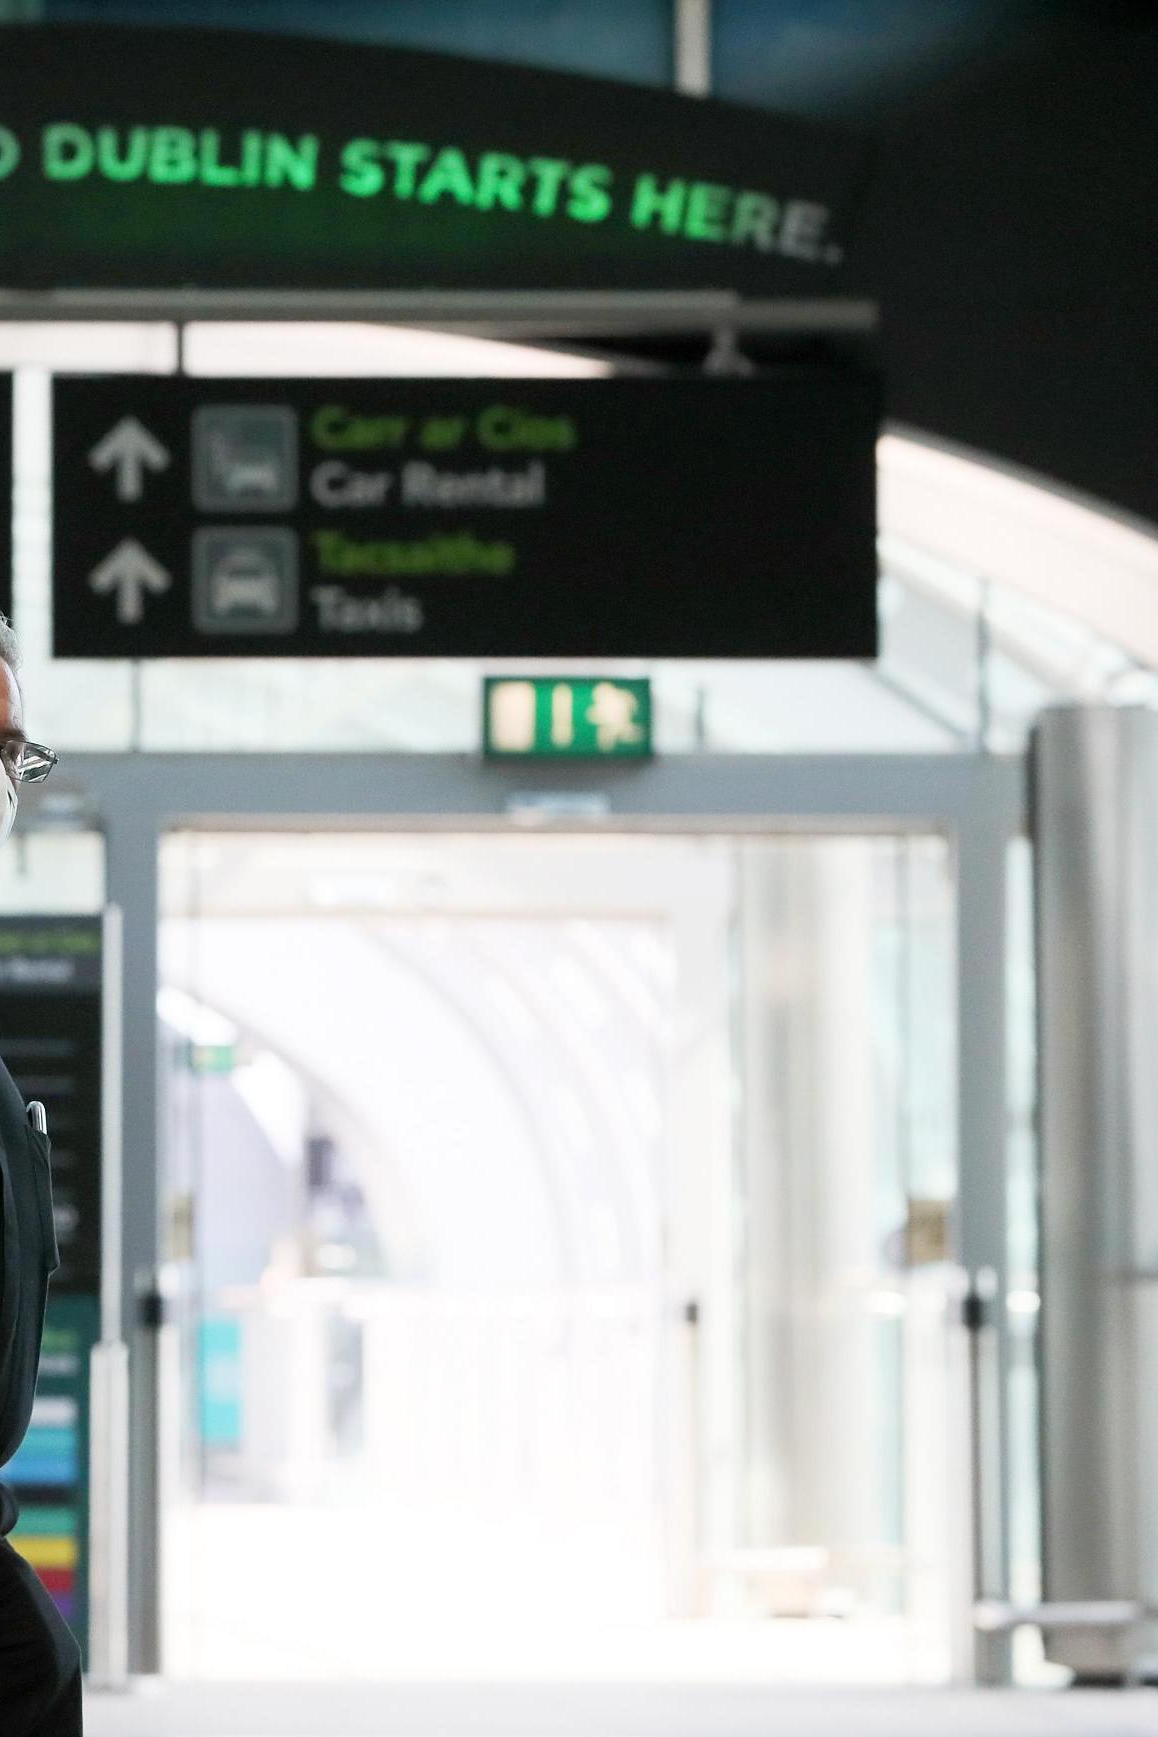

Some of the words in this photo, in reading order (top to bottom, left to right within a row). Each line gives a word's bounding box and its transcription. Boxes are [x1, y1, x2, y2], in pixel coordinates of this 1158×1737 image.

[45, 125, 318, 191] DUBLIN
[341, 140, 611, 222] STARTS
[630, 174, 842, 264] HERE.
[311, 461, 391, 508] Car
[402, 462, 545, 507] Rental
[312, 586, 422, 632] Taxis
